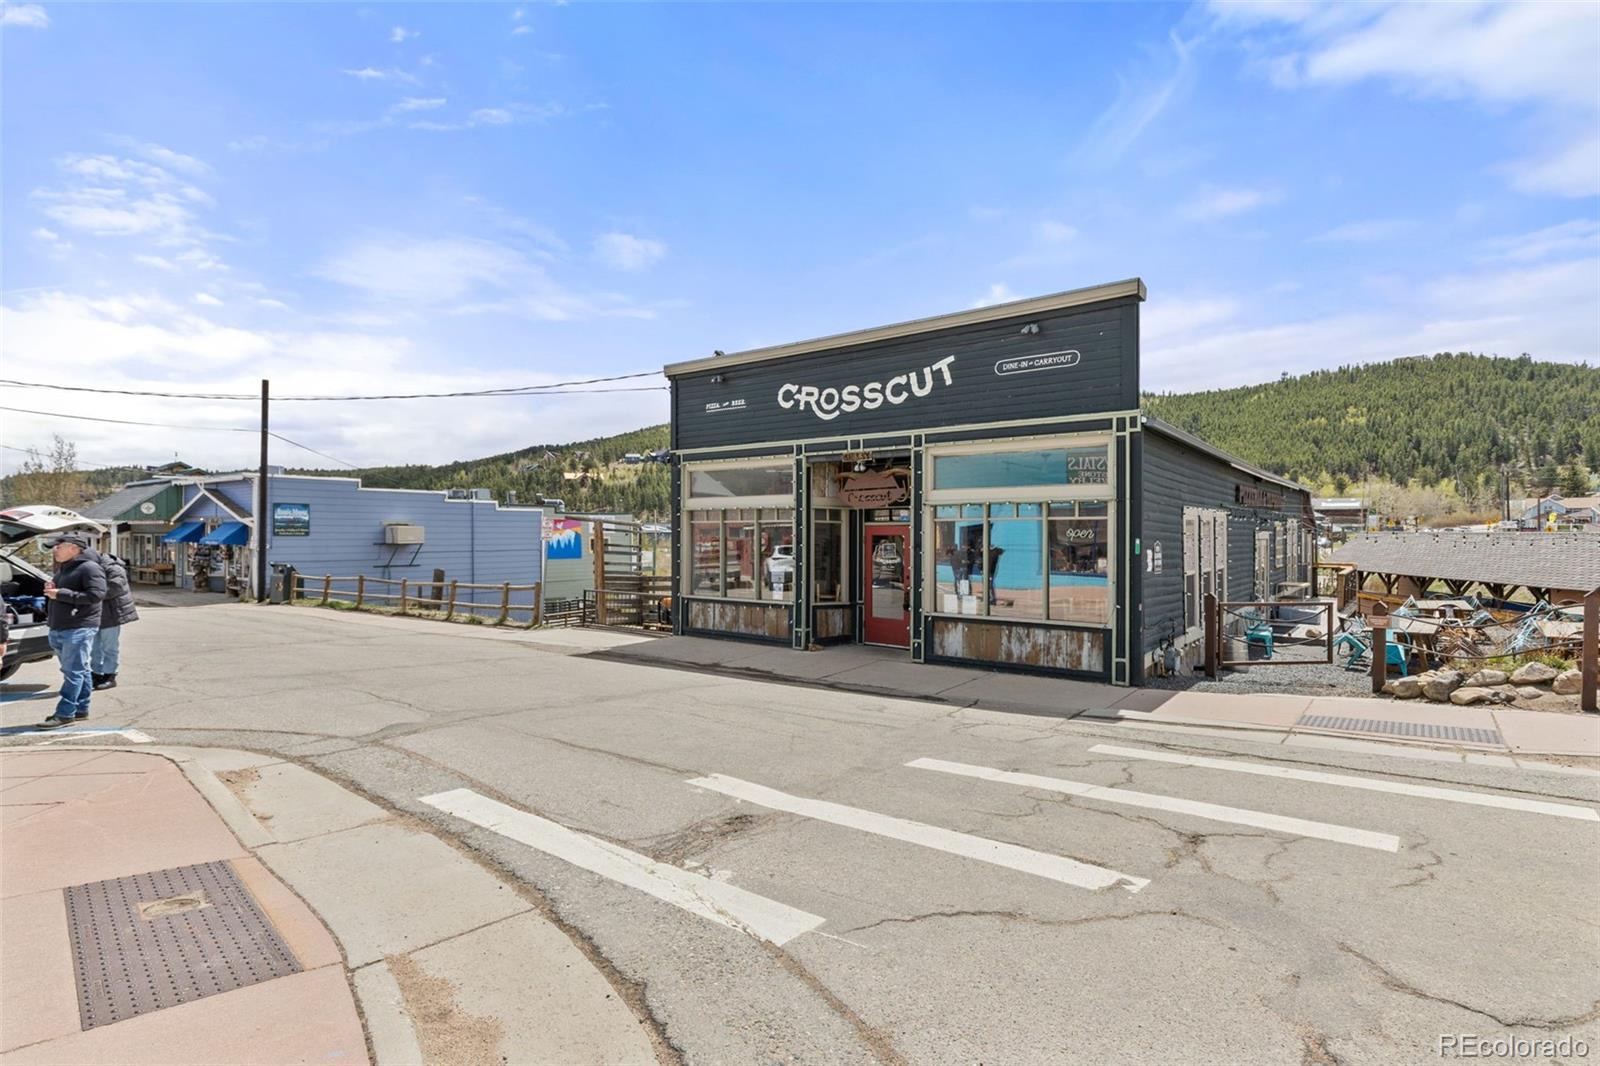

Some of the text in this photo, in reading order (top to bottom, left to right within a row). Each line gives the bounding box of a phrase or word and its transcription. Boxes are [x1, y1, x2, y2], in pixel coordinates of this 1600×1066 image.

[1003, 355, 1073, 371] DINE-IN CARRYOUT
[777, 355, 956, 421] CROSSCUT
[1066, 527, 1095, 541] open
